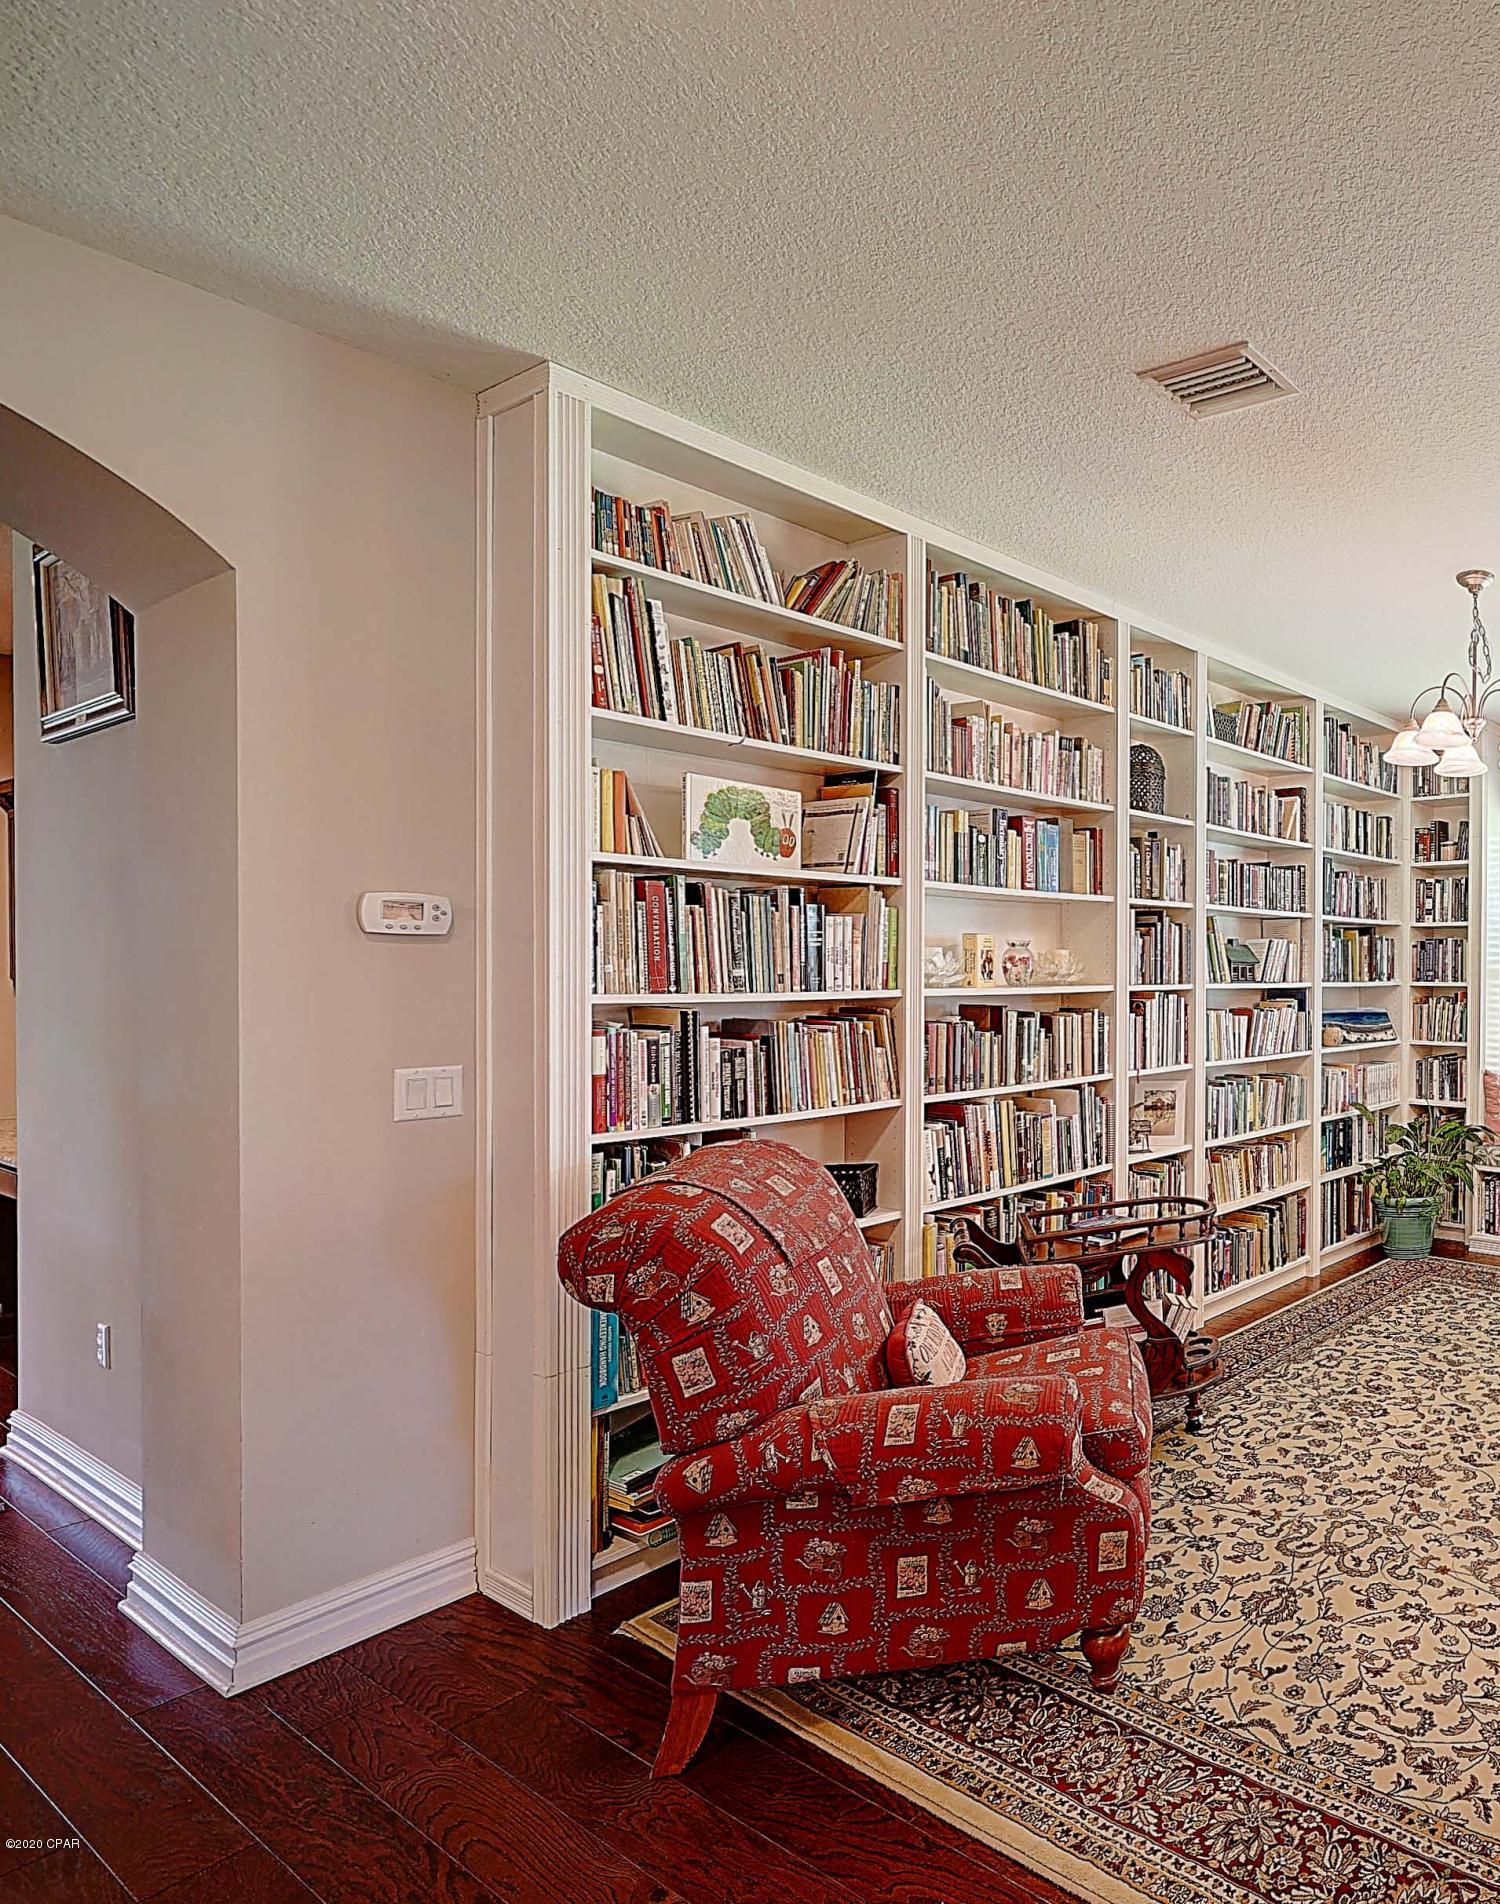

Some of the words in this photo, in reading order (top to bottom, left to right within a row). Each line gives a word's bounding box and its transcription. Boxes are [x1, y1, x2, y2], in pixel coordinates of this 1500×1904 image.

[1025, 832, 1034, 883] DICTIONARY
[651, 895, 661, 961] CONVERSATION
[599, 1351, 608, 1388] HANDBOOK
